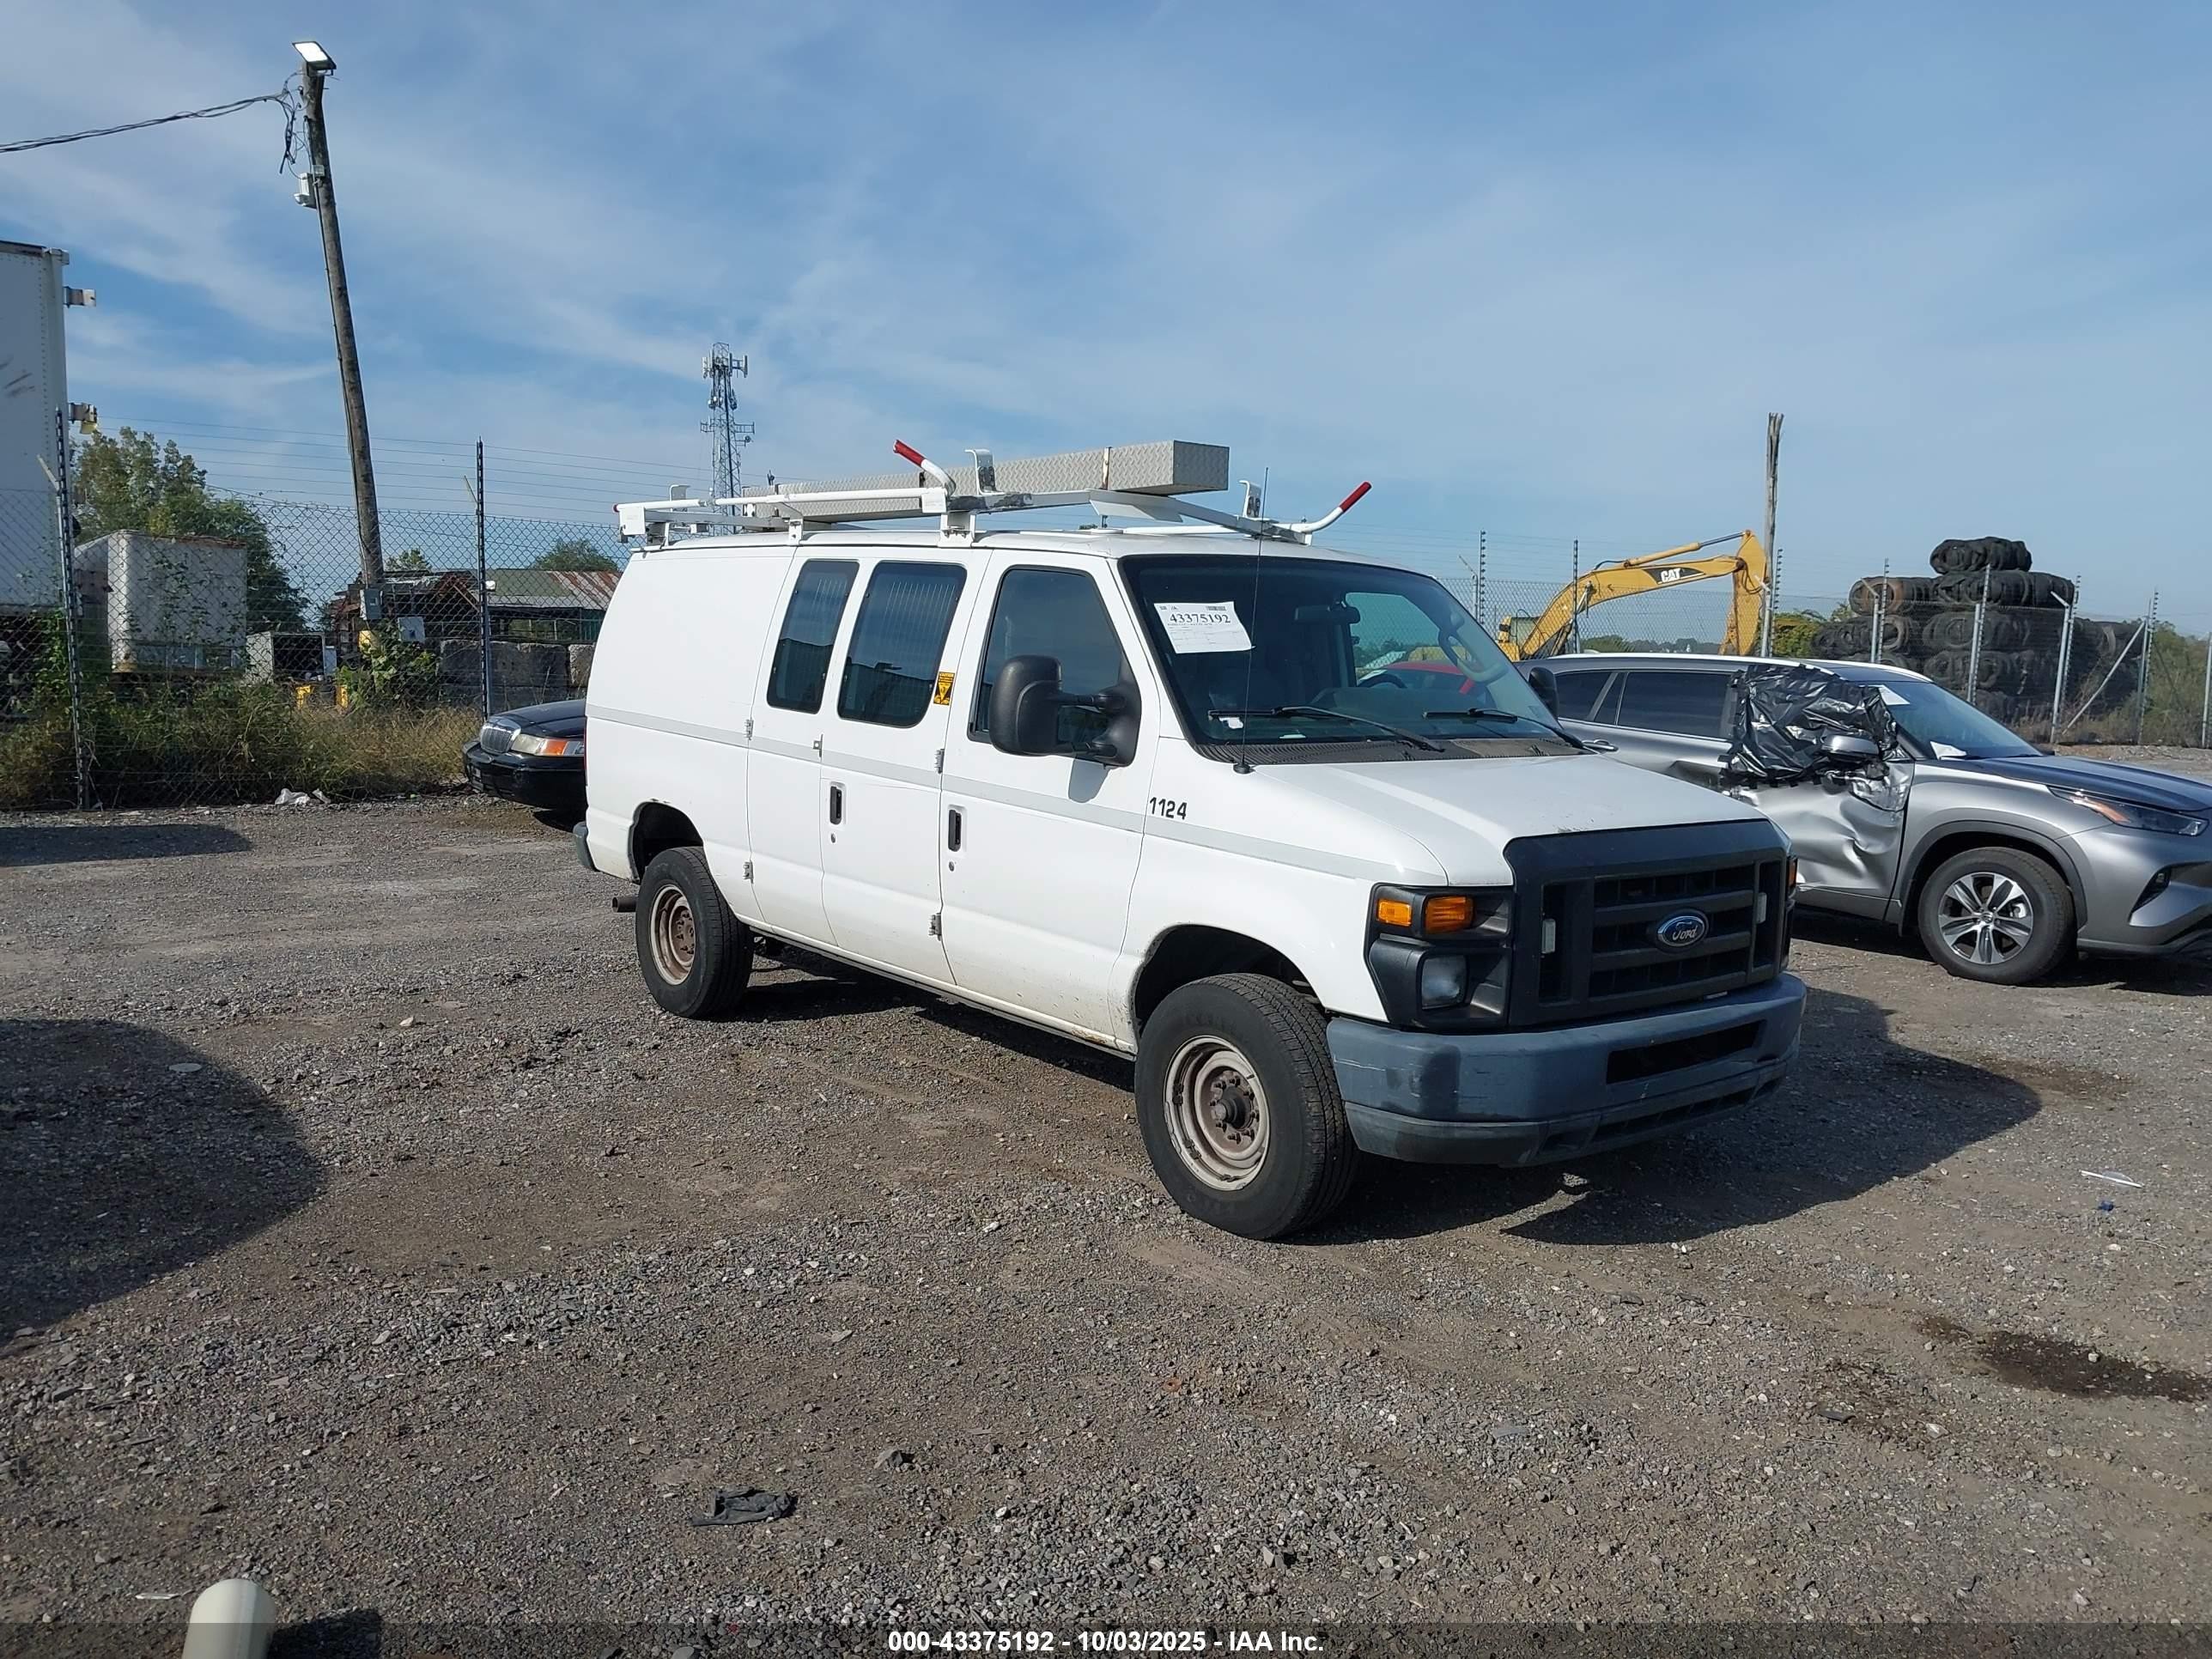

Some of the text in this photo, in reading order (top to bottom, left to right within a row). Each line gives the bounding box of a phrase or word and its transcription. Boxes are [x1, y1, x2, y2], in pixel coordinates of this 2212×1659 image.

[1661, 568, 1680, 582] CAT
[1170, 613, 1231, 623] 43375192
[1149, 796, 1188, 820] 1124
[1672, 921, 1698, 941] Ford
